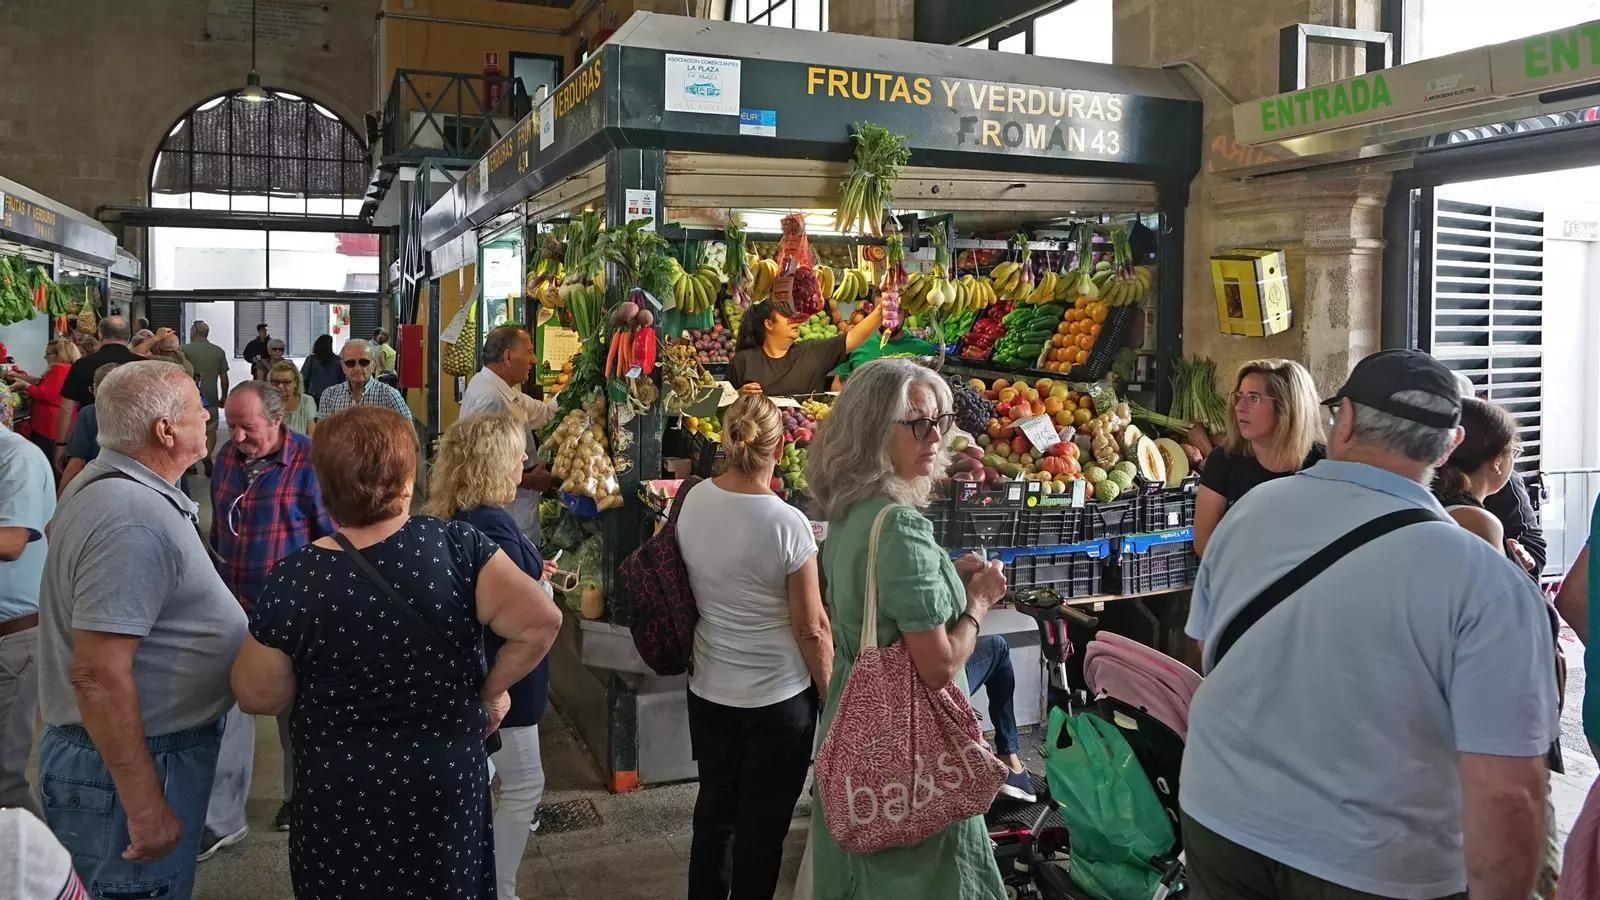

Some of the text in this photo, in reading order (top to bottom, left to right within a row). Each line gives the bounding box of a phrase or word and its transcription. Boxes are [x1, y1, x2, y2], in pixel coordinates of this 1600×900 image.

[553, 59, 602, 120] VERDURAS
[807, 66, 1122, 122] FRUTAS Y VERDURAS
[1260, 73, 1392, 132] ENTRADA
[1091, 129, 1120, 155] 43
[5, 195, 26, 215] FRUTAS
[32, 205, 56, 226] VERDURAS
